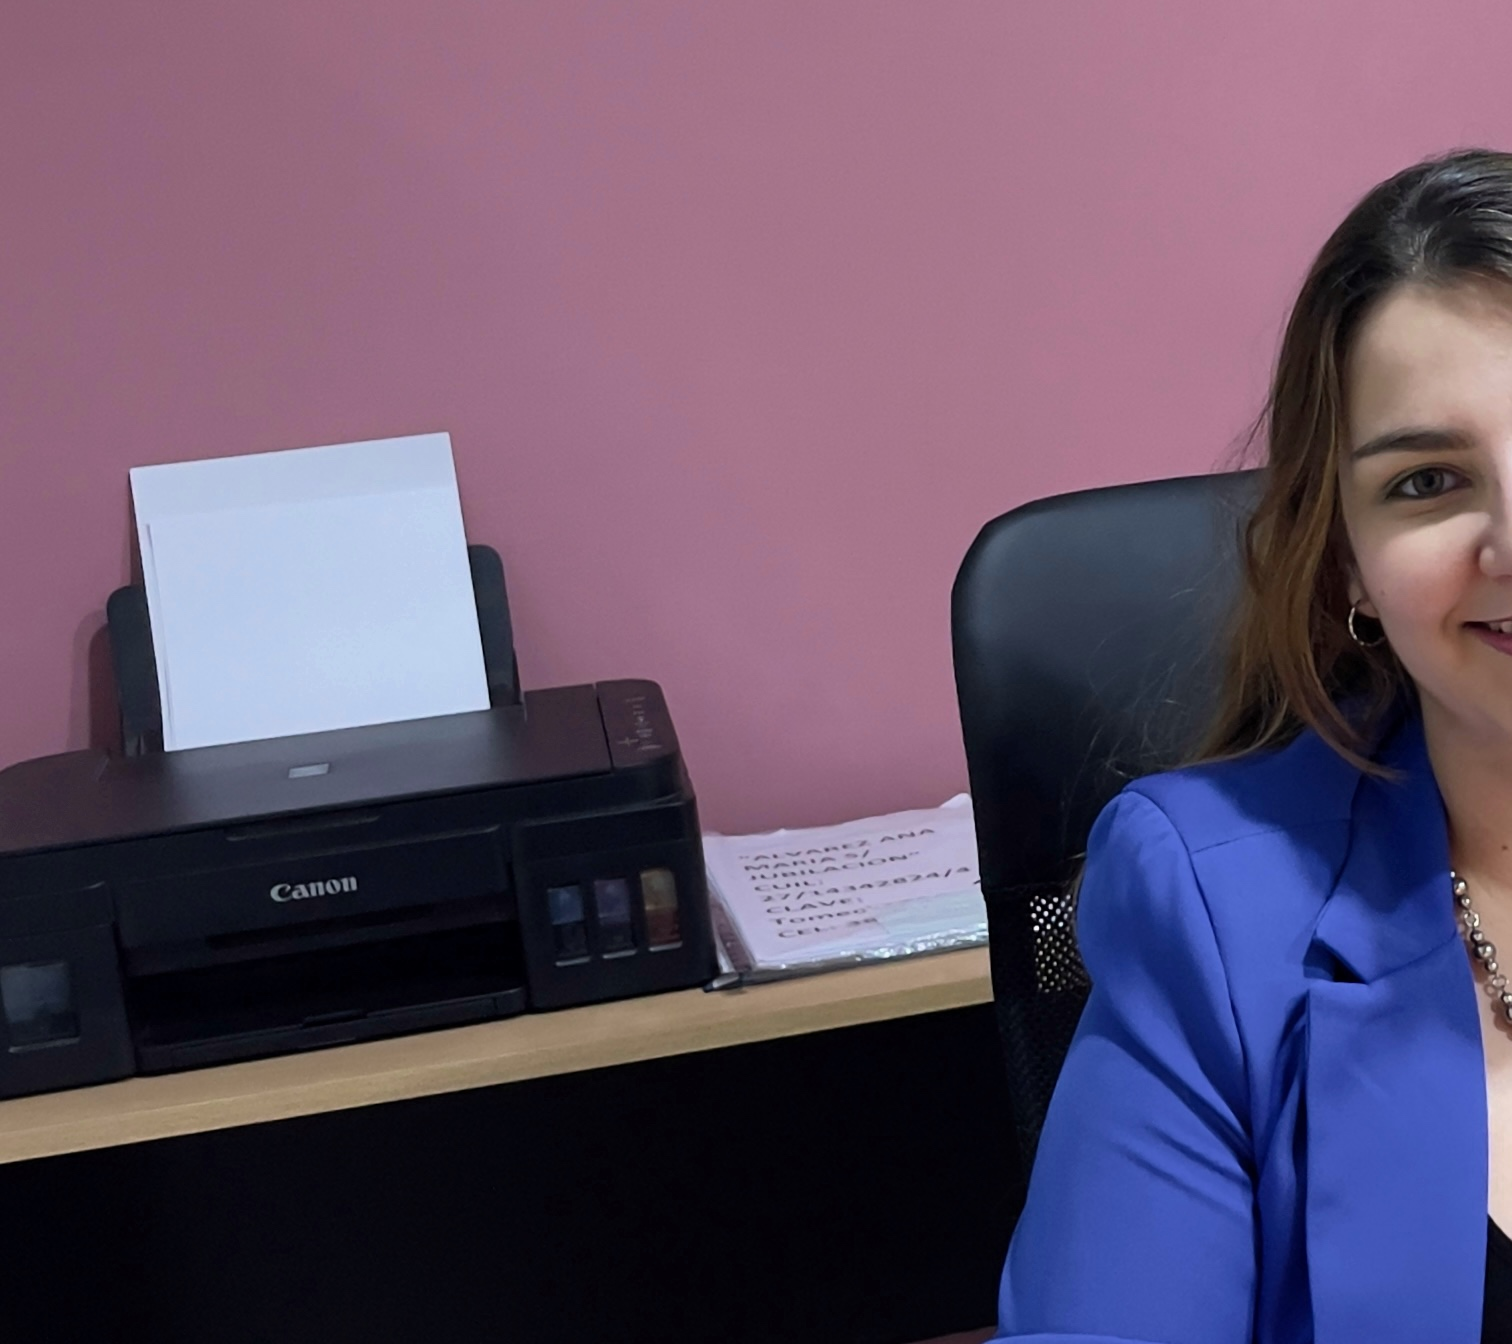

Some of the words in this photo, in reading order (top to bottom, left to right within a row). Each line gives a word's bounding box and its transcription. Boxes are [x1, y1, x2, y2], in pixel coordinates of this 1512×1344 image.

[880, 828, 935, 843] ANA
[743, 855, 837, 871] MARIA
[270, 873, 358, 904] Canon
